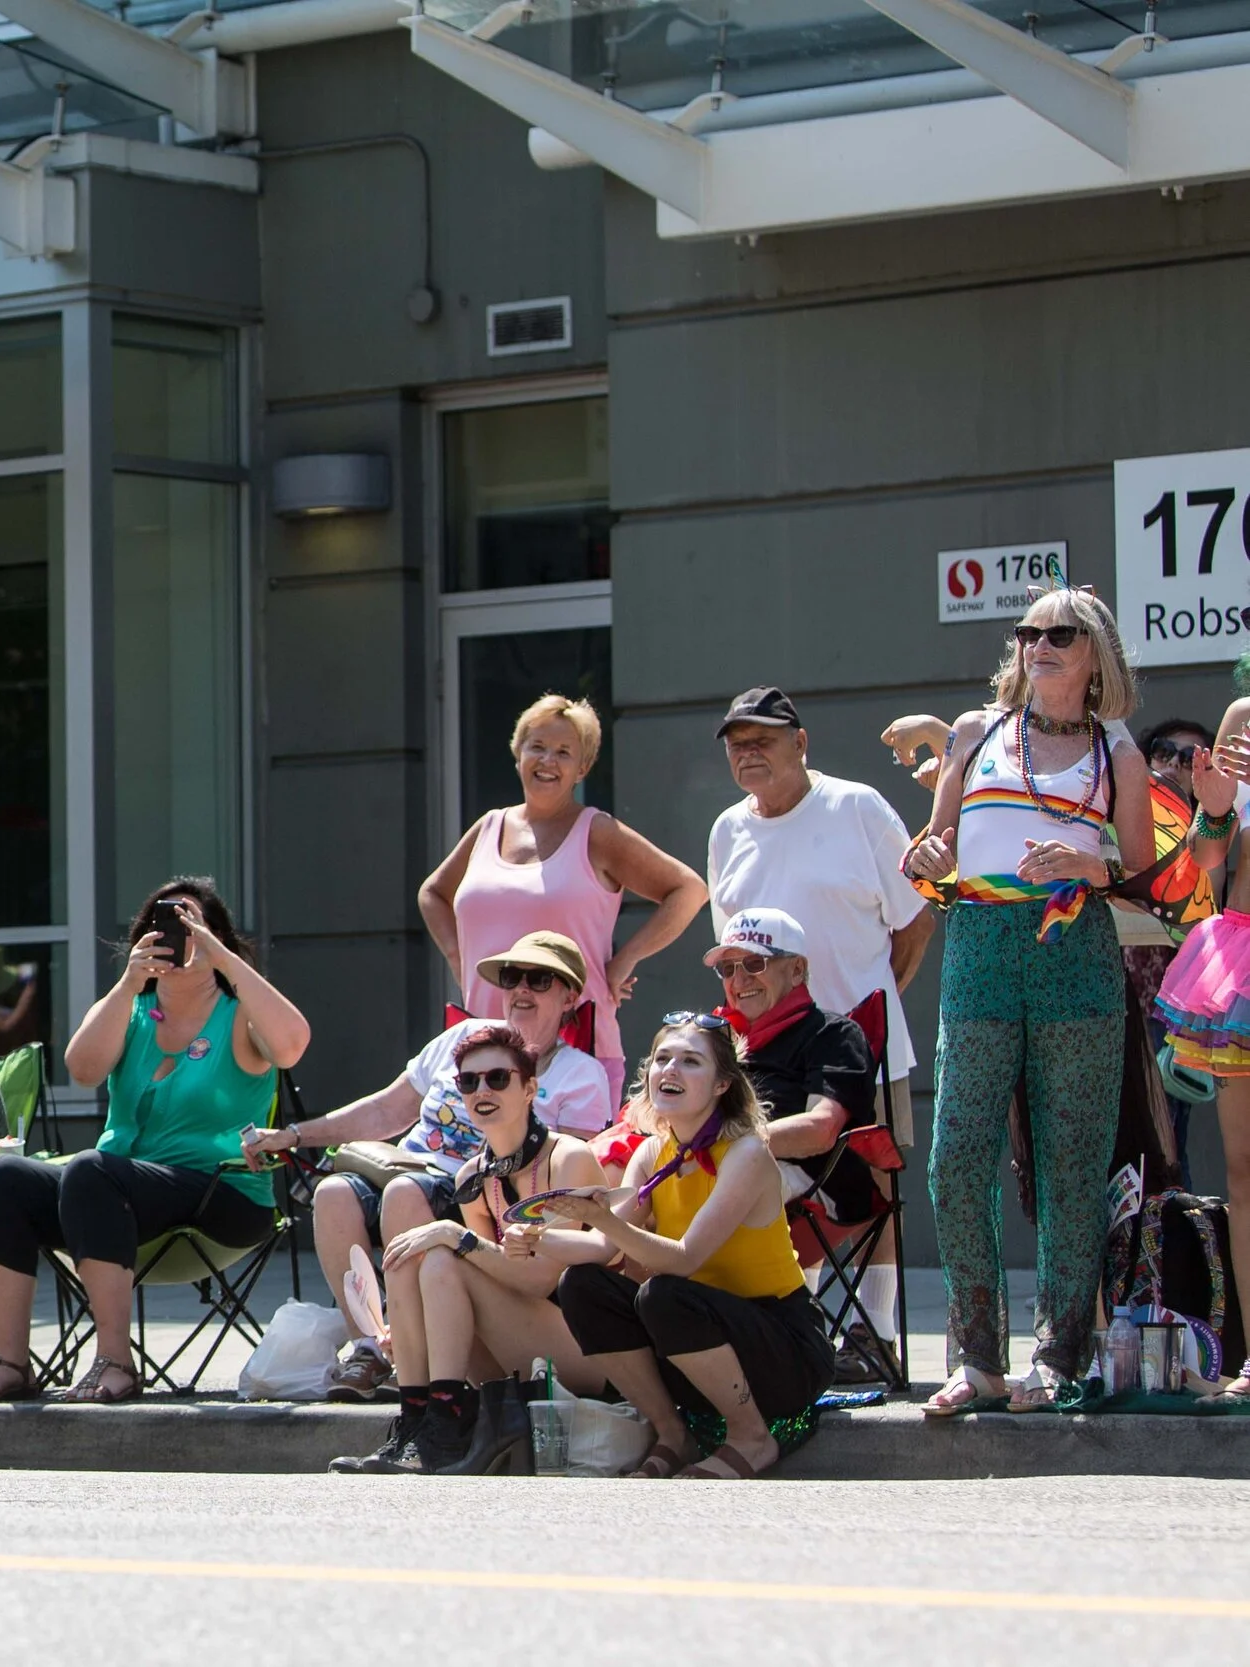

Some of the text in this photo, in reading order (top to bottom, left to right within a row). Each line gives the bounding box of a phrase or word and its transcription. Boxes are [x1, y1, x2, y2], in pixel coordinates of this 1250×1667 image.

[1143, 487, 1250, 578] 17
[995, 552, 1059, 582] 1766
[946, 600, 985, 614] SAFEWAY
[996, 594, 1042, 609] ROBS
[1145, 597, 1245, 640] Robs
[1199, 1326, 1219, 1365] COMMUNITY
